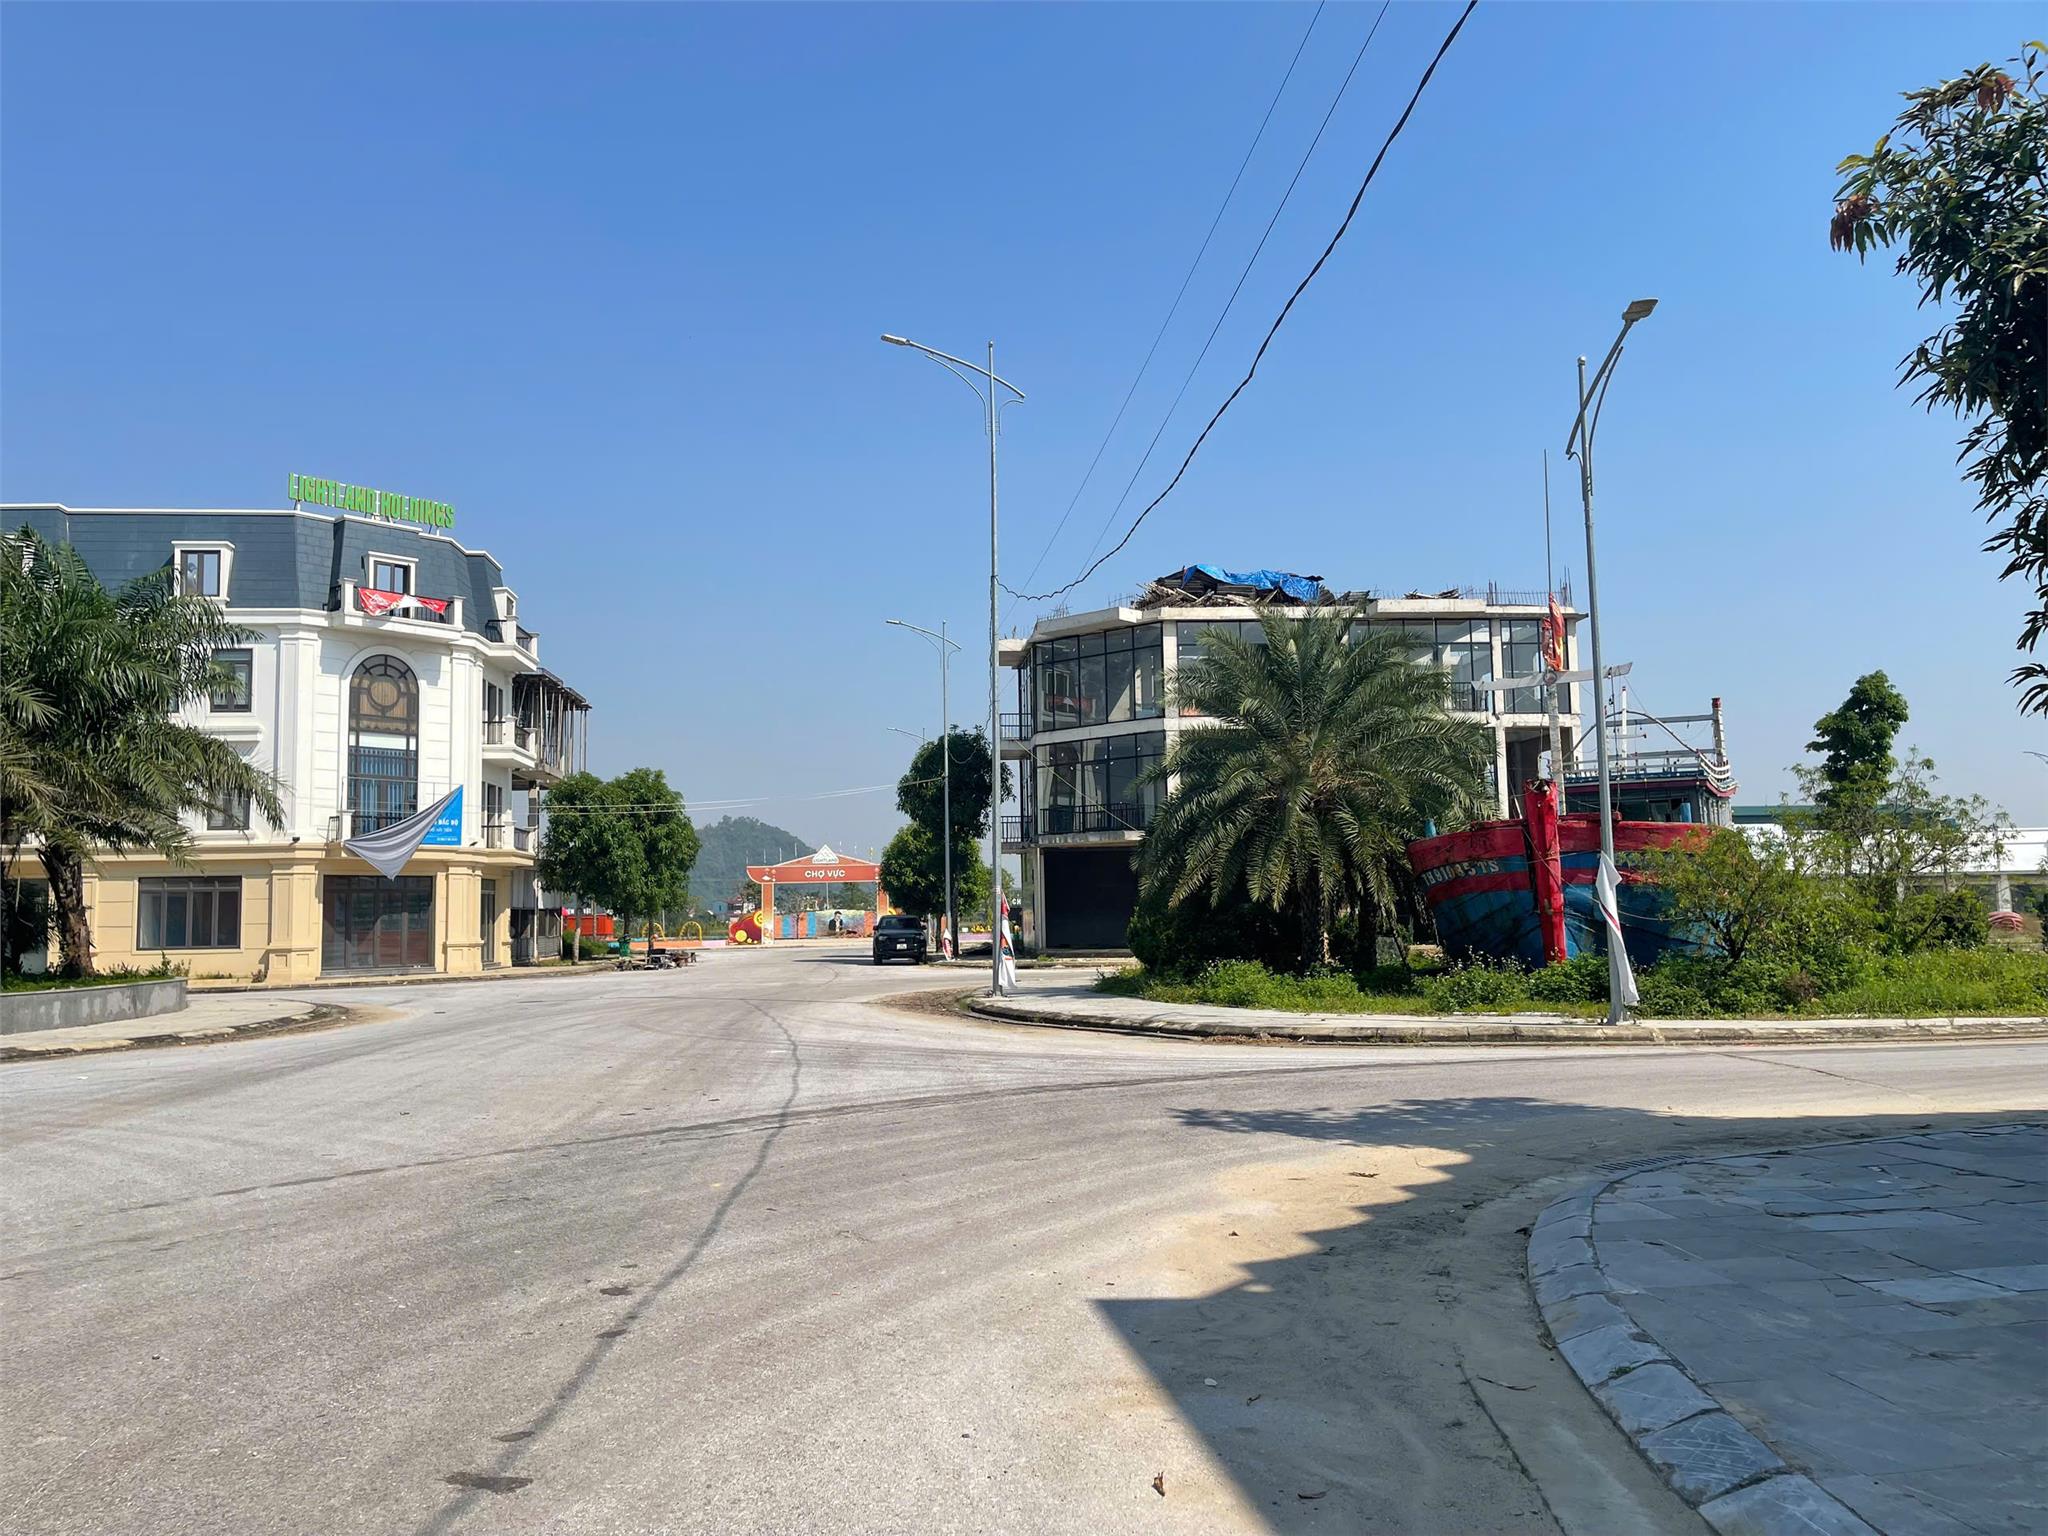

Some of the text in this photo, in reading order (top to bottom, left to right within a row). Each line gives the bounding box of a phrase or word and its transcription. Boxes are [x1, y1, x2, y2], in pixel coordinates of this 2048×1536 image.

[288, 472, 456, 529] LIGHTLAND HOLDINGS
[804, 868, 846, 879] CHỢ VỰC
